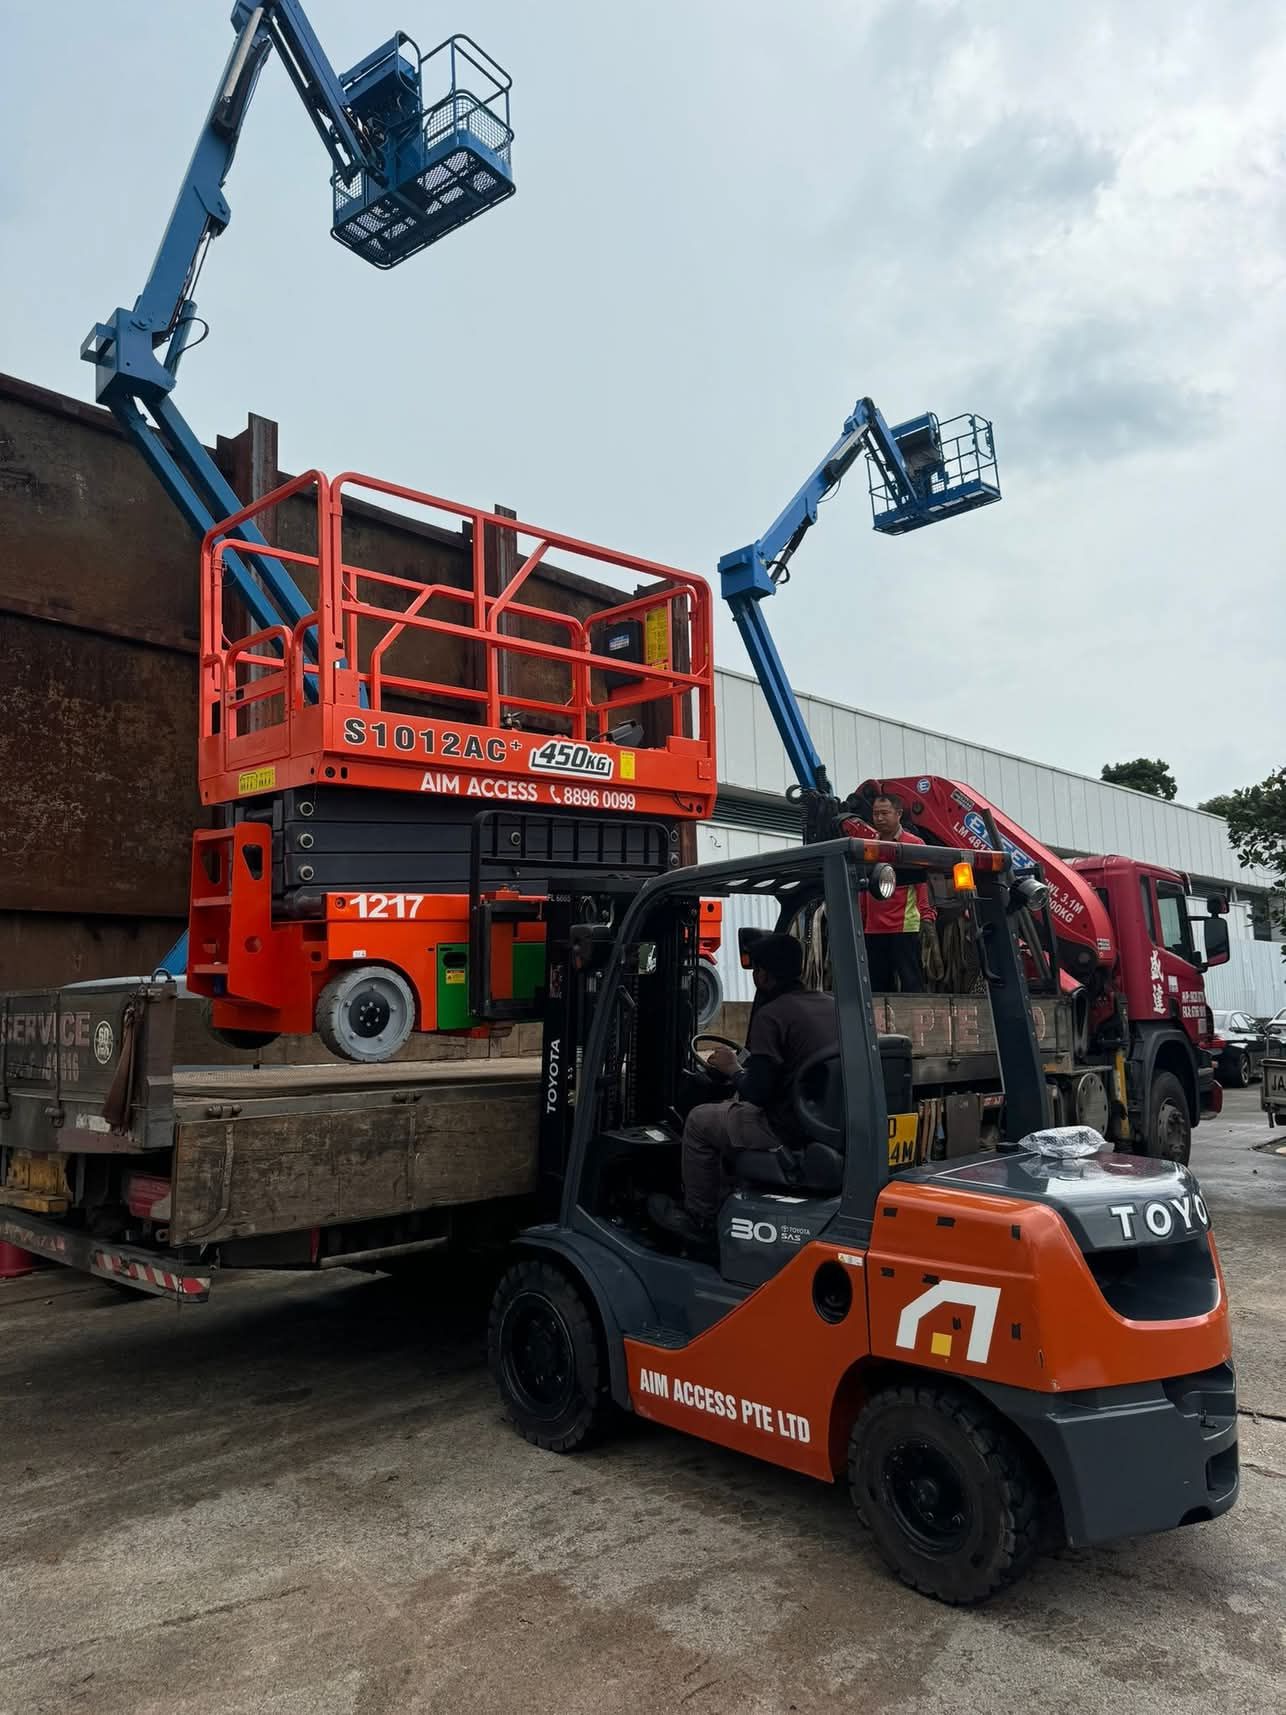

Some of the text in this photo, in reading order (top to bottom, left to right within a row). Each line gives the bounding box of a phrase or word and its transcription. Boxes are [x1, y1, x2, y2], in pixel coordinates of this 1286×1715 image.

[539, 742, 607, 771] 450KG
[420, 772, 538, 801] AIM ACCESS
[563, 787, 635, 810] 8896 0099
[953, 821, 969, 839] LM
[349, 893, 424, 919] 1217
[1045, 878, 1084, 915] WL 3.1M
[1049, 897, 1075, 923] 00KG
[546, 1038, 560, 1114] TOYOTA
[731, 1217, 777, 1243] 30
[781, 1232, 801, 1242] SAS
[789, 1226, 811, 1236] TOYOTA
[640, 1367, 811, 1444] AIM ACCESS PTE LTD
